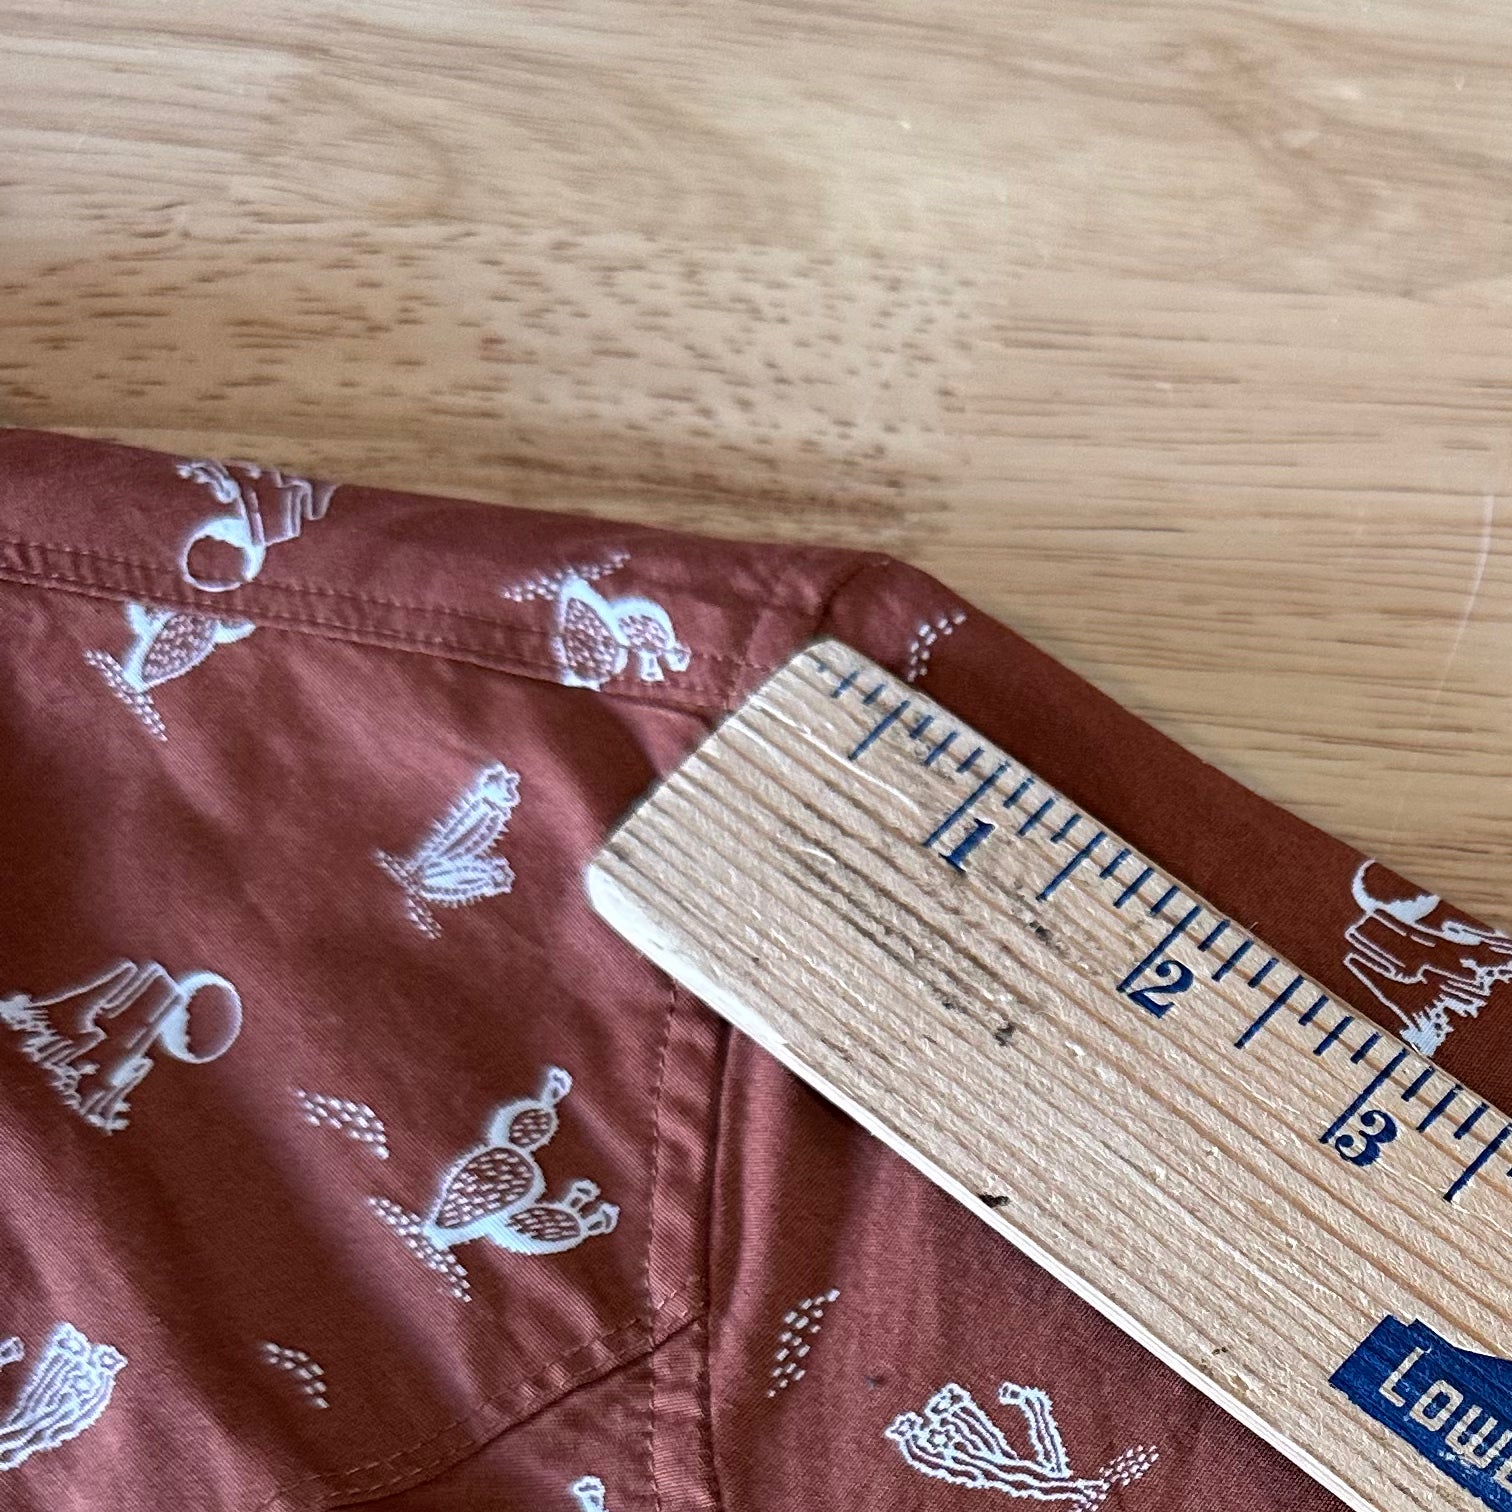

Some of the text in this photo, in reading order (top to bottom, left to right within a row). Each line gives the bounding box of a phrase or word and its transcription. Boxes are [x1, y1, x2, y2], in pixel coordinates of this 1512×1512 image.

[938, 819, 996, 875] 1
[1127, 959, 1195, 1019] 2
[1334, 1109, 1398, 1167] 3
